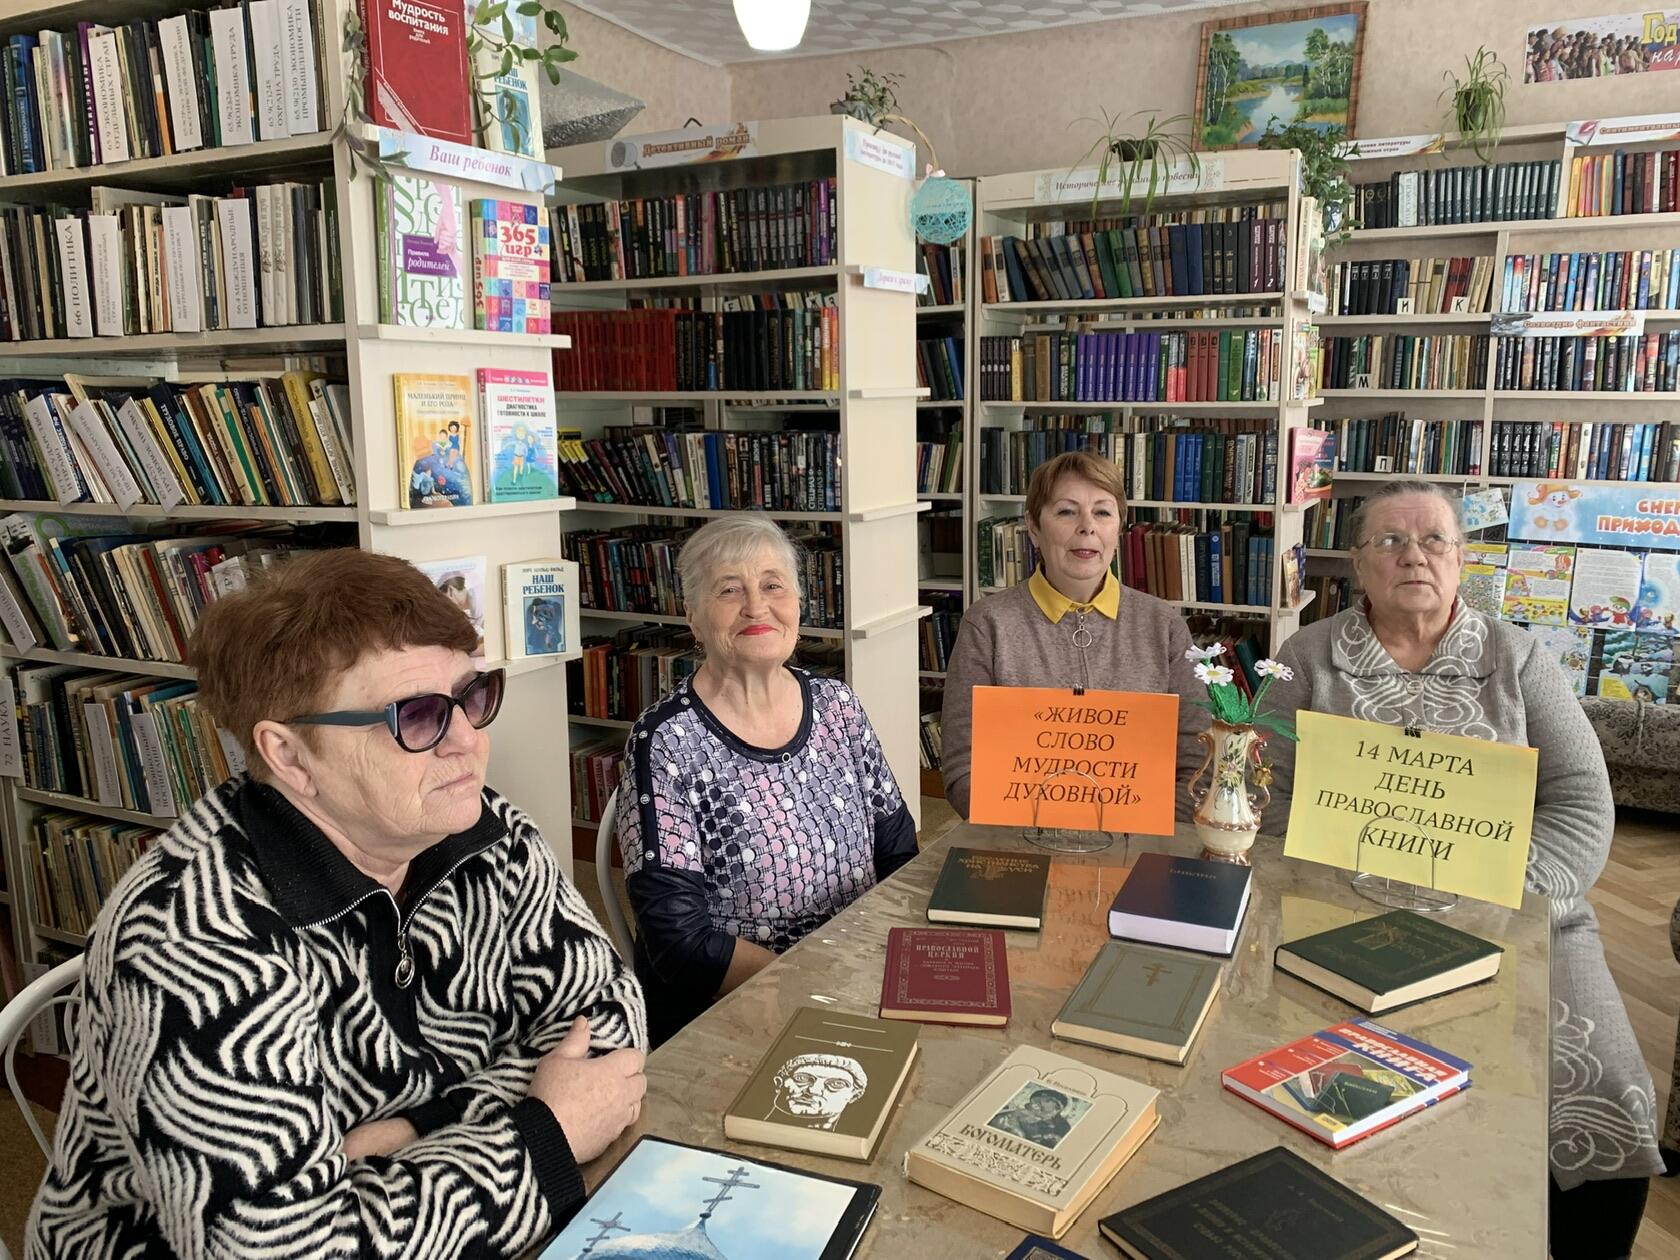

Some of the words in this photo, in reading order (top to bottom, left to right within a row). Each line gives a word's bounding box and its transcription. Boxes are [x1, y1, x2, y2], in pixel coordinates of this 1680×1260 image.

[388, 9, 449, 36] воспитания
[392, 0, 446, 22] Мудрость
[228, 26, 238, 61] ТРУДА
[287, 5, 298, 74] ЭКОНОМИКА
[1641, 12, 1678, 46] Год
[102, 40, 114, 78] СТРАН
[273, 44, 281, 79] ТРУДА
[295, 8, 309, 119] ПРОМЫШЛЕННОСТИ
[97, 56, 110, 129] ЭКОНОМИКА
[231, 63, 242, 133] ЭКОНОМИКА
[275, 81, 283, 127] ОХРАНА
[429, 144, 460, 167] Ваш
[463, 156, 512, 177] ребенок
[643, 136, 713, 157] Детективный
[716, 133, 750, 149] роман
[229, 208, 240, 296] МЕЖДУНАРОДНЫЕ
[500, 226, 536, 244] 365
[503, 245, 532, 257] игр
[65, 224, 81, 306] ПОЛИТИКА
[407, 255, 450, 271] родителей
[240, 252, 249, 315] ОТНОШЕНИЯ
[1454, 300, 1462, 312] К
[1358, 375, 1369, 387] М
[128, 410, 148, 443] ПРАВО
[160, 403, 181, 438] ТРУДОВОЕ
[177, 437, 190, 461] ПРАВО
[33, 411, 62, 483] ГОСУДАРСТВО
[1379, 458, 1387, 467] П
[807, 476, 816, 510] СПЕЦНАЗ
[816, 476, 826, 510] СПЕЦНАЗ
[523, 584, 565, 595] РЕБЕНОК
[532, 574, 554, 585] НАШ
[0, 700, 12, 747] НАУКА
[1034, 706, 1129, 726] «ЖИВОЕ
[1036, 731, 1115, 751] СЛОВО
[1355, 740, 1381, 760] 14
[1387, 746, 1475, 776] МАРТА
[1012, 757, 1139, 779] МУДРОСТИ
[1004, 782, 1142, 805] ДУХОВНОЙ»
[1374, 772, 1446, 800] ДЕНЬ
[1316, 790, 1515, 842] ПРАВОСЛАВНОЙ
[1360, 826, 1455, 861] КНИГИ
[916, 944, 979, 953] ПРАВОСЛАВНОЙ
[928, 951, 964, 959] ЦЕРКВИ
[1338, 1028, 1448, 1078] ПРАВОСЛАВНАЯ
[1352, 1042, 1438, 1082] КНИГА
[960, 1124, 1062, 1170] БОГОМАТЕРЬ
